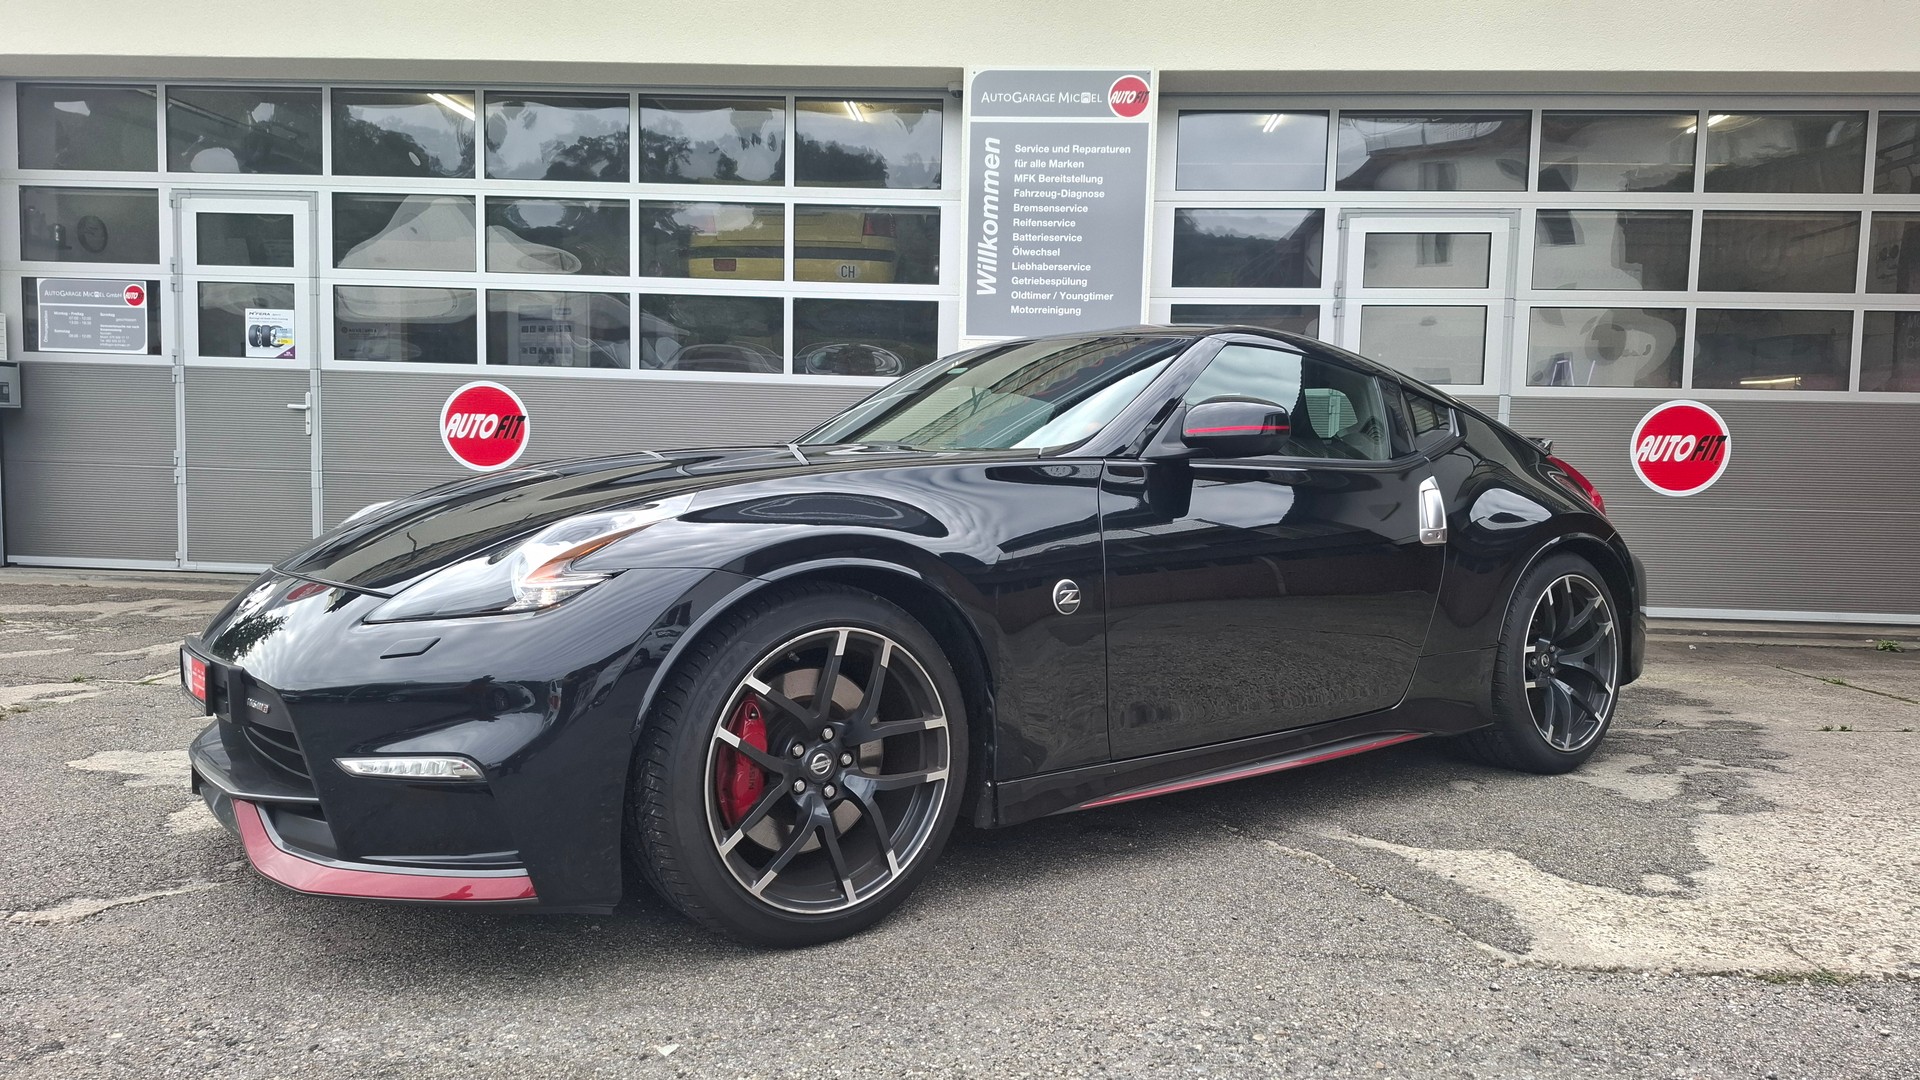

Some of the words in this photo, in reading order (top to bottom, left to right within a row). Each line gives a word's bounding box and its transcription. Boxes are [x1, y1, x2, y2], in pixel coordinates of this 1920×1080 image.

[1014, 144, 1050, 153] Service
[1052, 145, 1070, 153] und
[1072, 145, 1131, 155] Reparaturen
[1014, 159, 1028, 168] für
[1030, 160, 1046, 168] alle
[1048, 160, 1085, 168] Marken
[1014, 174, 1036, 183] MFK
[1038, 174, 1104, 185] Bereitstellung
[1013, 189, 1105, 199] Fahrzeug-Diagnose
[1013, 203, 1089, 213] Bremsenservice
[976, 137, 1001, 295] Willkommen
[1012, 218, 1076, 227] Reifenservice
[1012, 232, 1083, 242] Batterieservice
[1012, 246, 1061, 256] Ölwechsel
[841, 265, 855, 278] CH
[1011, 262, 1092, 271] Liebhaberservice
[1011, 277, 1088, 287] Getriebespülung
[1011, 291, 1051, 300] Oldtimer
[1060, 291, 1114, 302] Youngtimer
[1010, 305, 1082, 316] Motorreinigung
[444, 412, 527, 439] AUTOFIT
[1635, 434, 1728, 462] AUTOFIT
